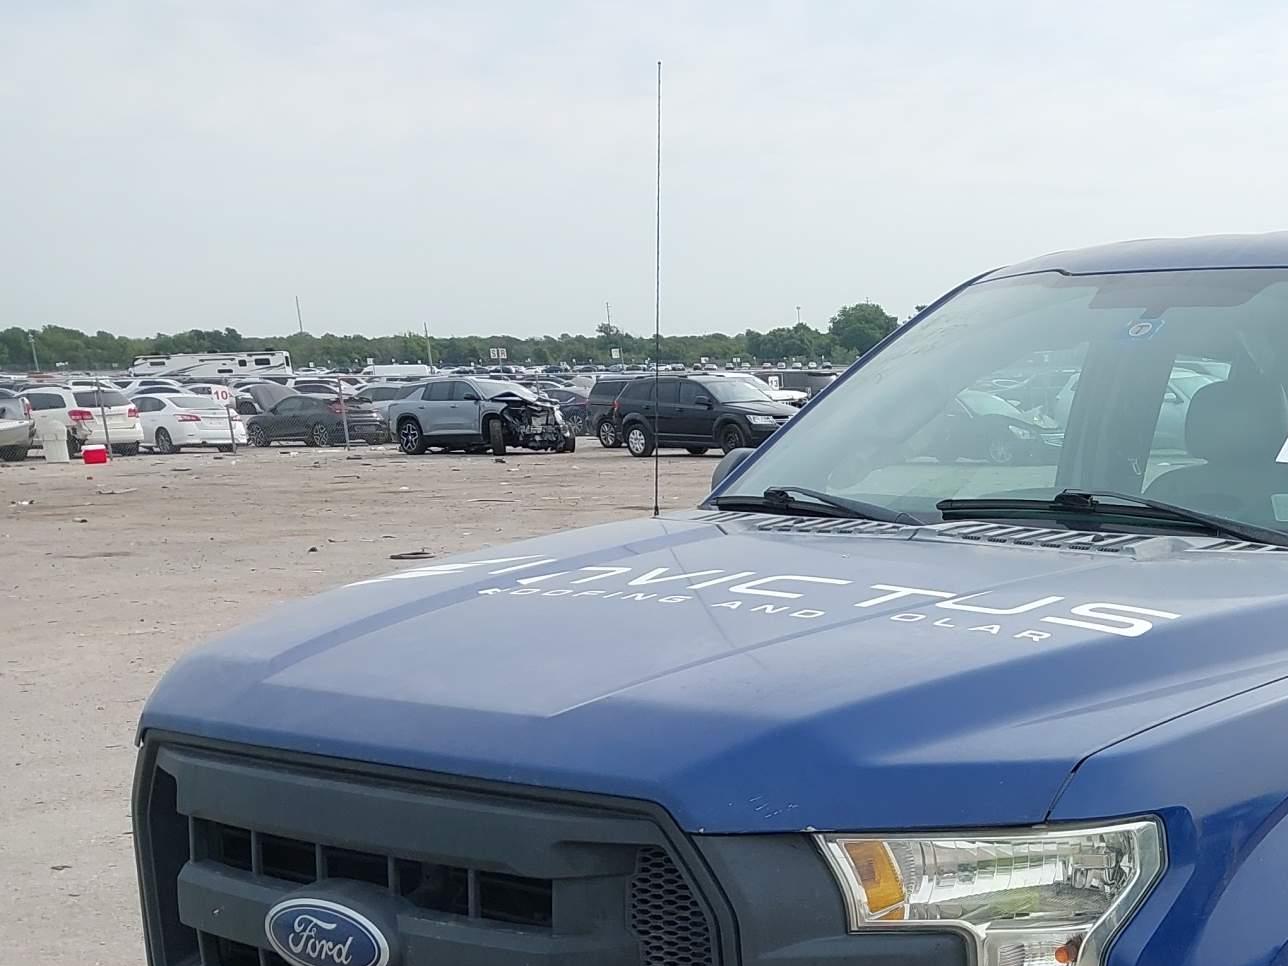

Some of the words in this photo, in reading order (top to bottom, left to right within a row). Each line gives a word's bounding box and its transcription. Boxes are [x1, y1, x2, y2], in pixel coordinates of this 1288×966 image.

[214, 390, 228, 400] 10
[476, 587, 694, 604] ROOFING
[711, 600, 826, 619] AND
[487, 557, 1182, 638] INVICTUS
[288, 914, 353, 965] Ford
